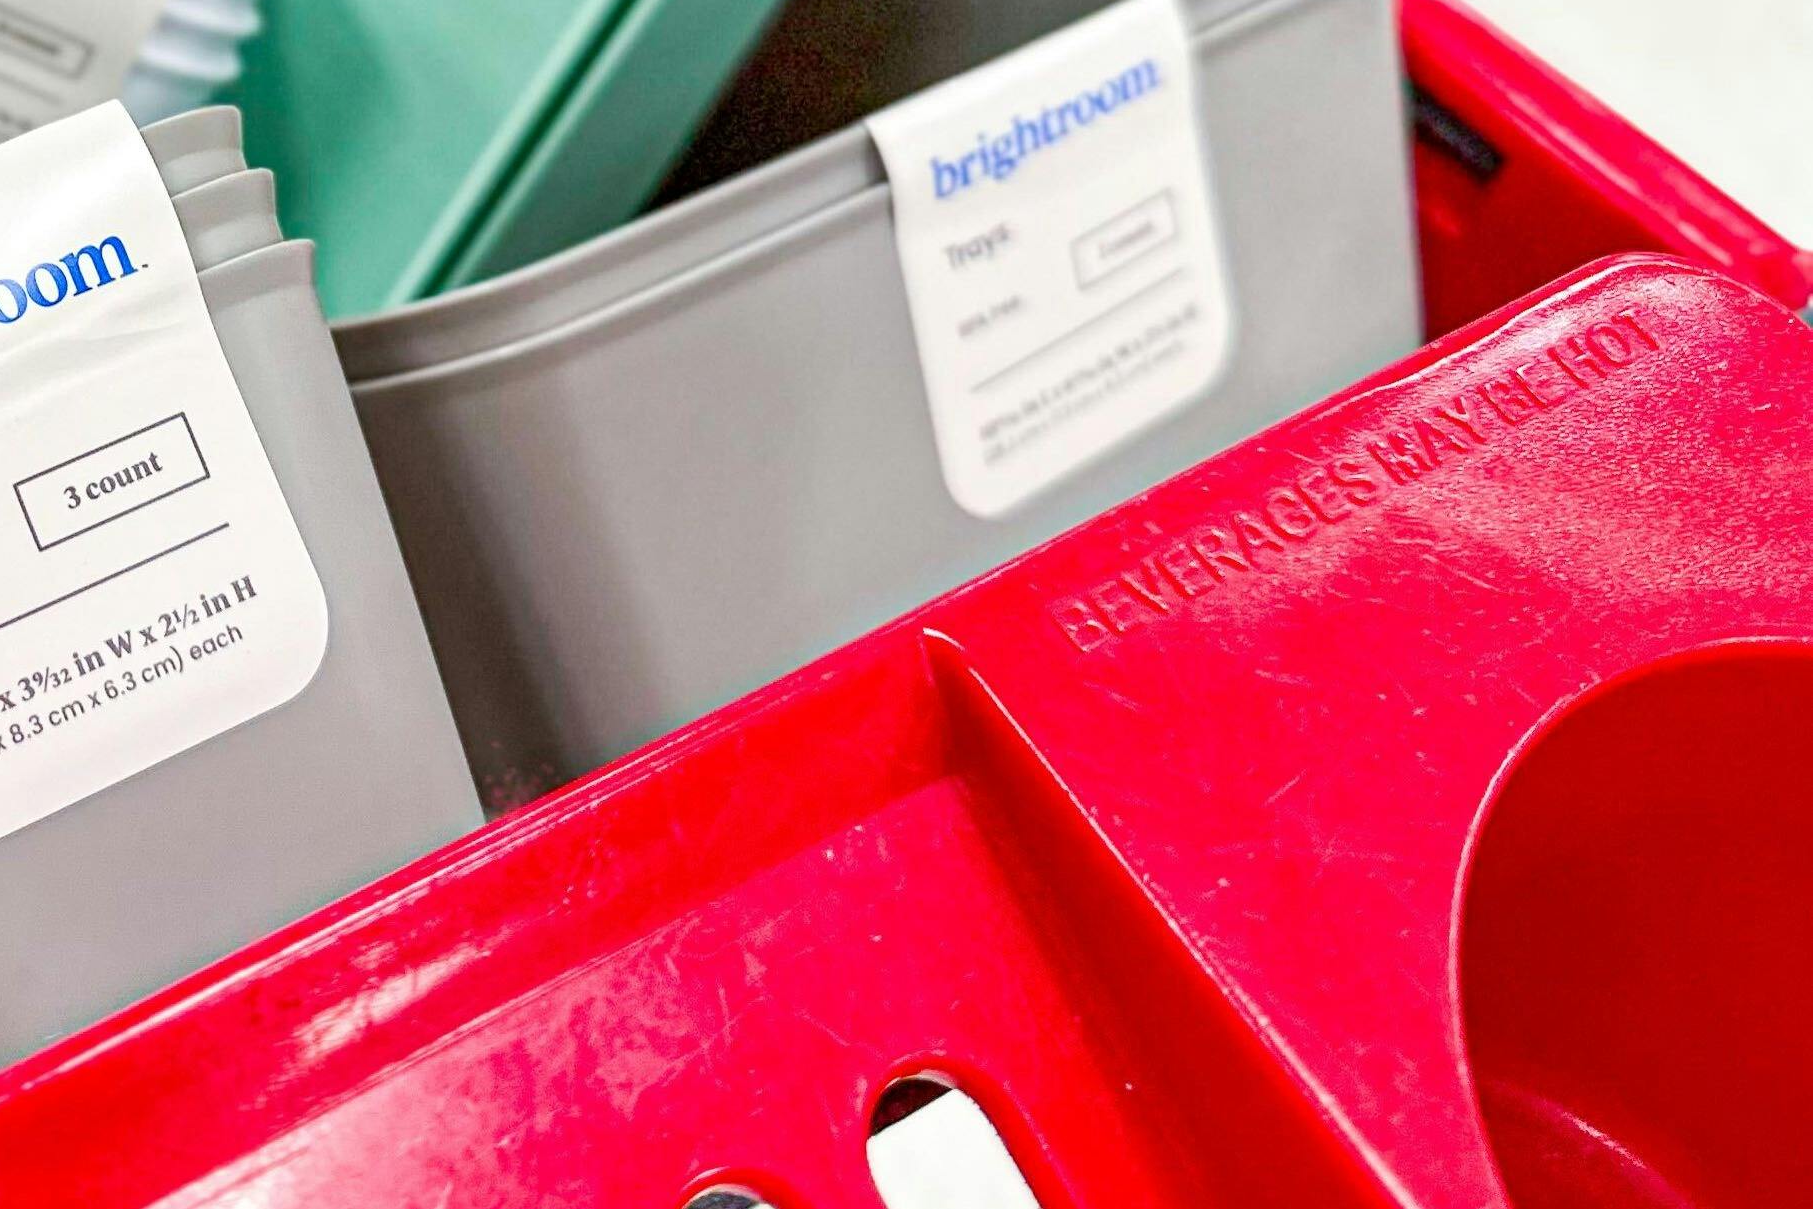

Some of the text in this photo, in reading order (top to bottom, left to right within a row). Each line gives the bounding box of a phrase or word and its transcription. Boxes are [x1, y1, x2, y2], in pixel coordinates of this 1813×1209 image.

[929, 58, 1163, 202] brightroom
[63, 451, 164, 510] 3 count
[1052, 304, 1663, 653] BEVERAGES MAY BE HOT
[0, 688, 19, 711] x
[72, 650, 106, 678] in
[104, 630, 134, 661] W
[140, 624, 159, 647] x
[200, 590, 233, 618] in
[229, 574, 259, 600] H
[9, 716, 45, 746] 8.3
[47, 701, 87, 728] cm
[88, 691, 103, 709] x
[103, 672, 138, 701] 6.3
[140, 645, 184, 686] cm)
[189, 623, 245, 661] each
